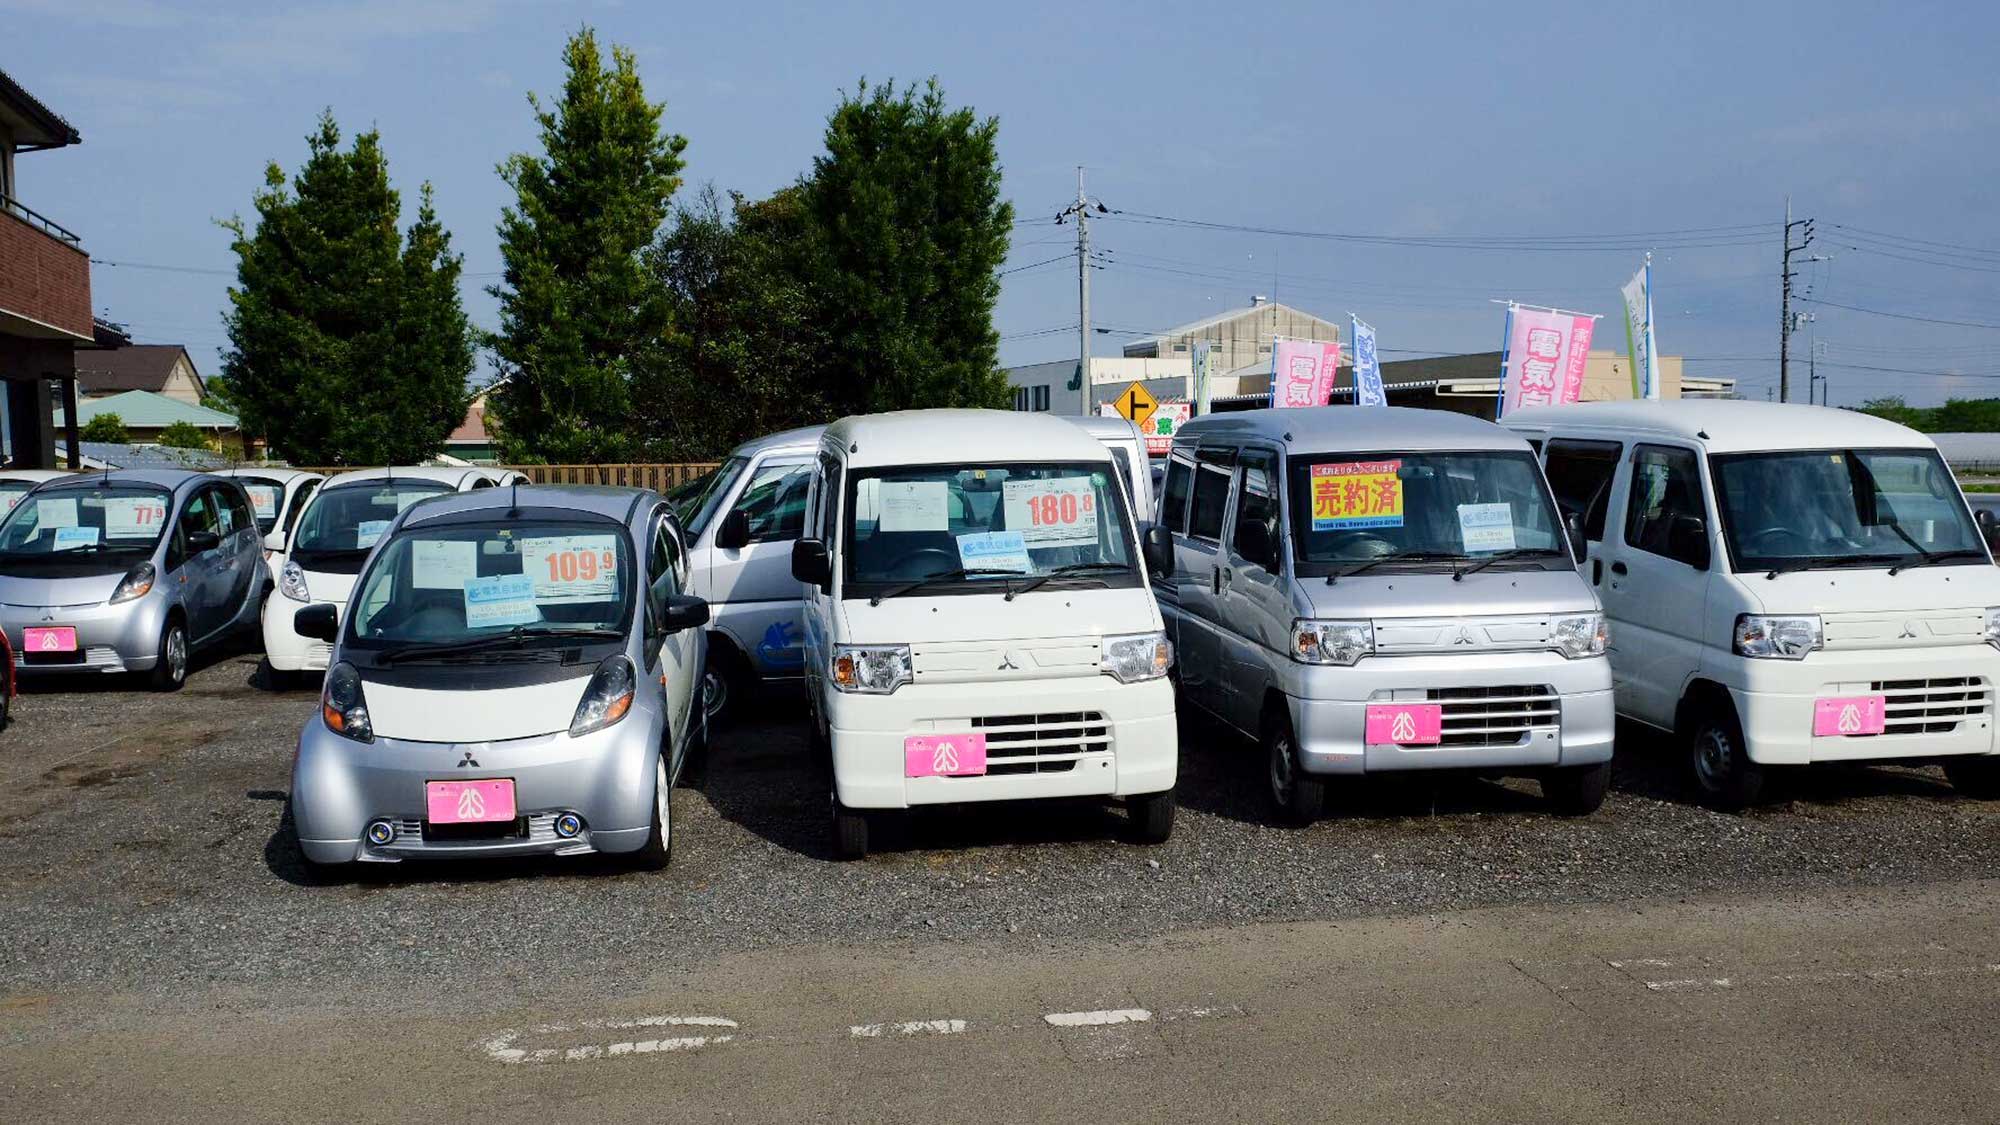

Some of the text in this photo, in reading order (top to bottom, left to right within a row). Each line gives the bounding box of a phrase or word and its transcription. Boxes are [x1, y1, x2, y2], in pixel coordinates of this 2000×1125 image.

[1286, 354, 1317, 406] 電気
[1315, 477, 1397, 516] 売約済
